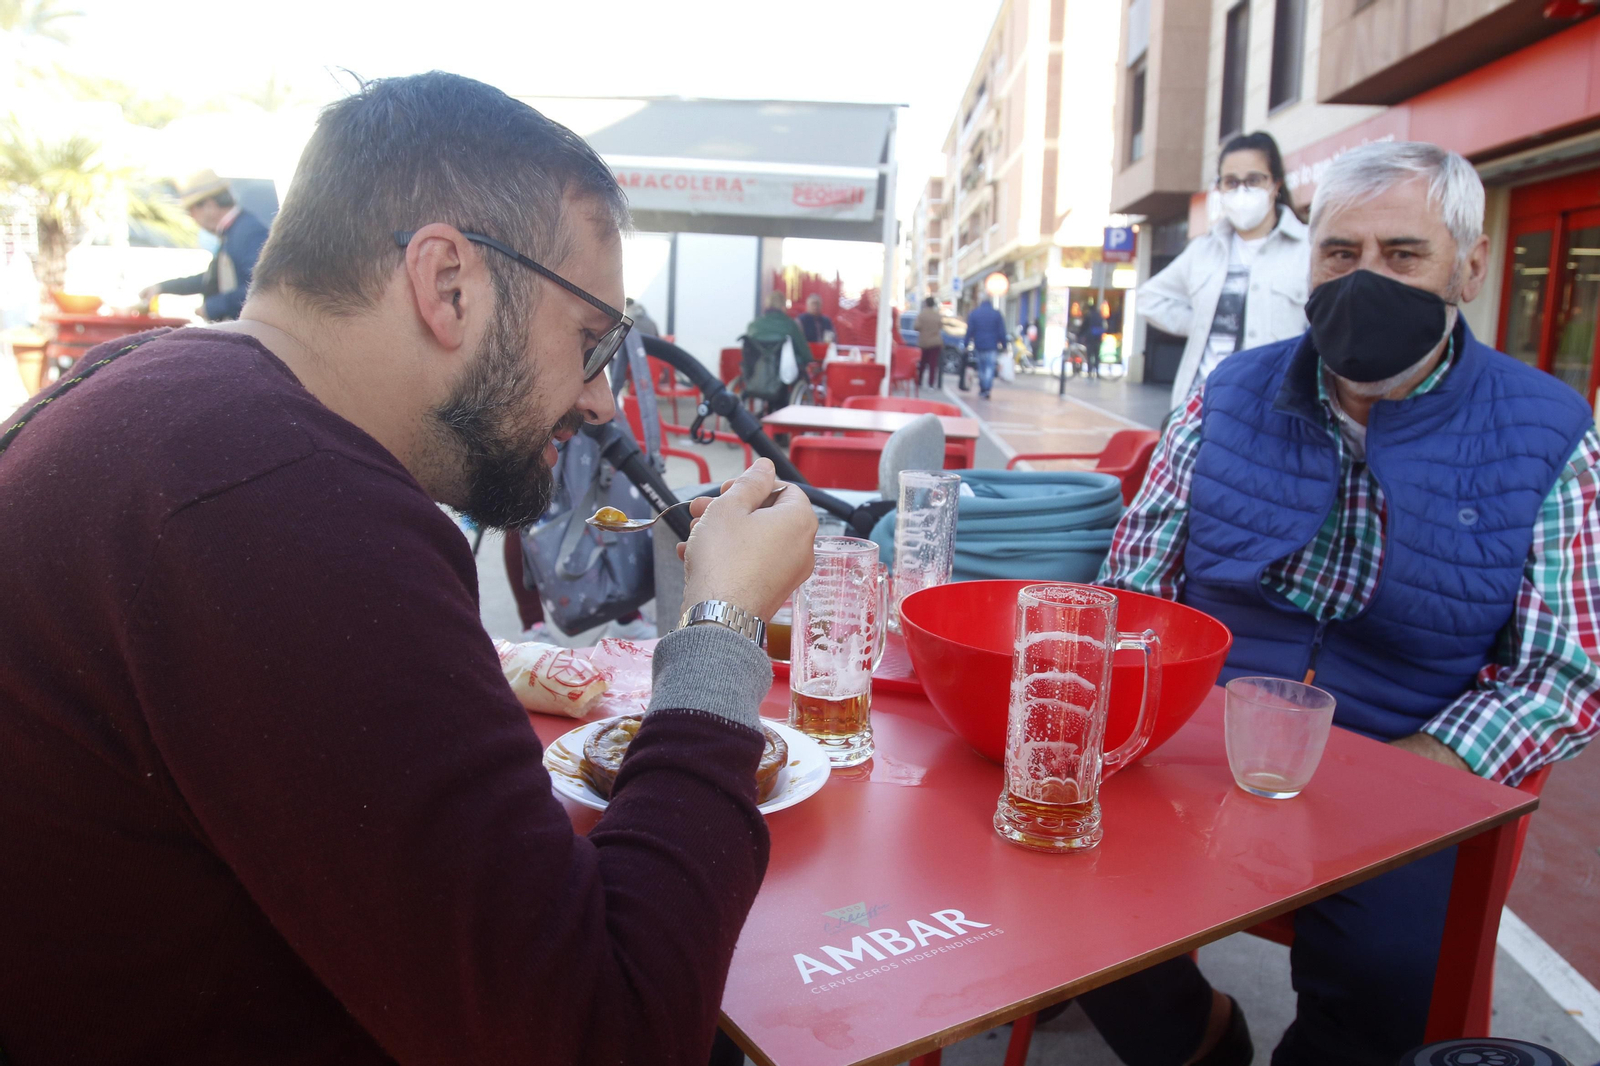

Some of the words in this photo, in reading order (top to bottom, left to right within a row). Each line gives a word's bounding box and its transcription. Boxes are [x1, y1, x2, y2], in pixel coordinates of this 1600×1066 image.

[1110, 228, 1126, 249] P
[793, 908, 992, 984] AMBAR
[811, 961, 899, 995] CERVECEROS
[901, 927, 1005, 966] INDEPENDIENTES
